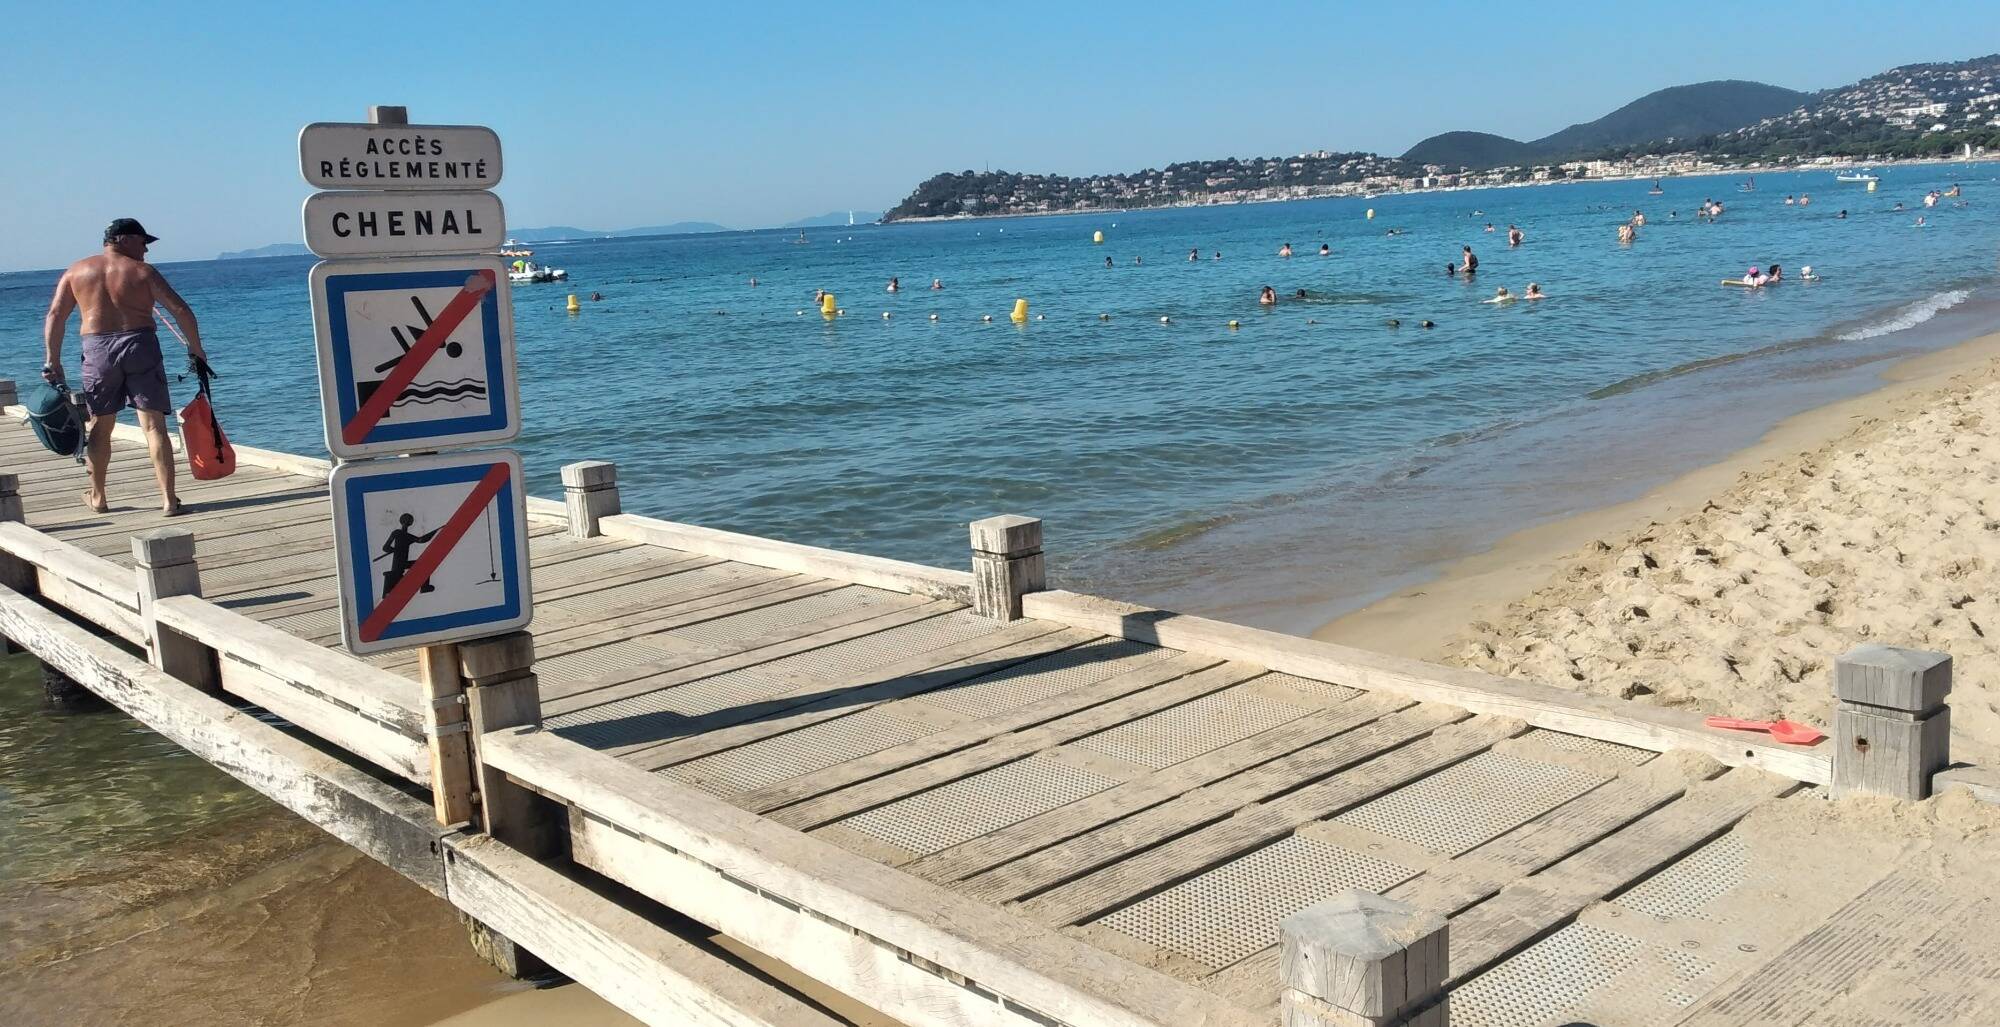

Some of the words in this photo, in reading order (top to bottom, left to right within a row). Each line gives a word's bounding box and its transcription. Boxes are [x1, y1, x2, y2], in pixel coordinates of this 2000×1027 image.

[366, 135, 443, 156] ACCÈS
[320, 157, 487, 178] RÉGLEMENTÉ
[332, 209, 482, 237] CHENAL
